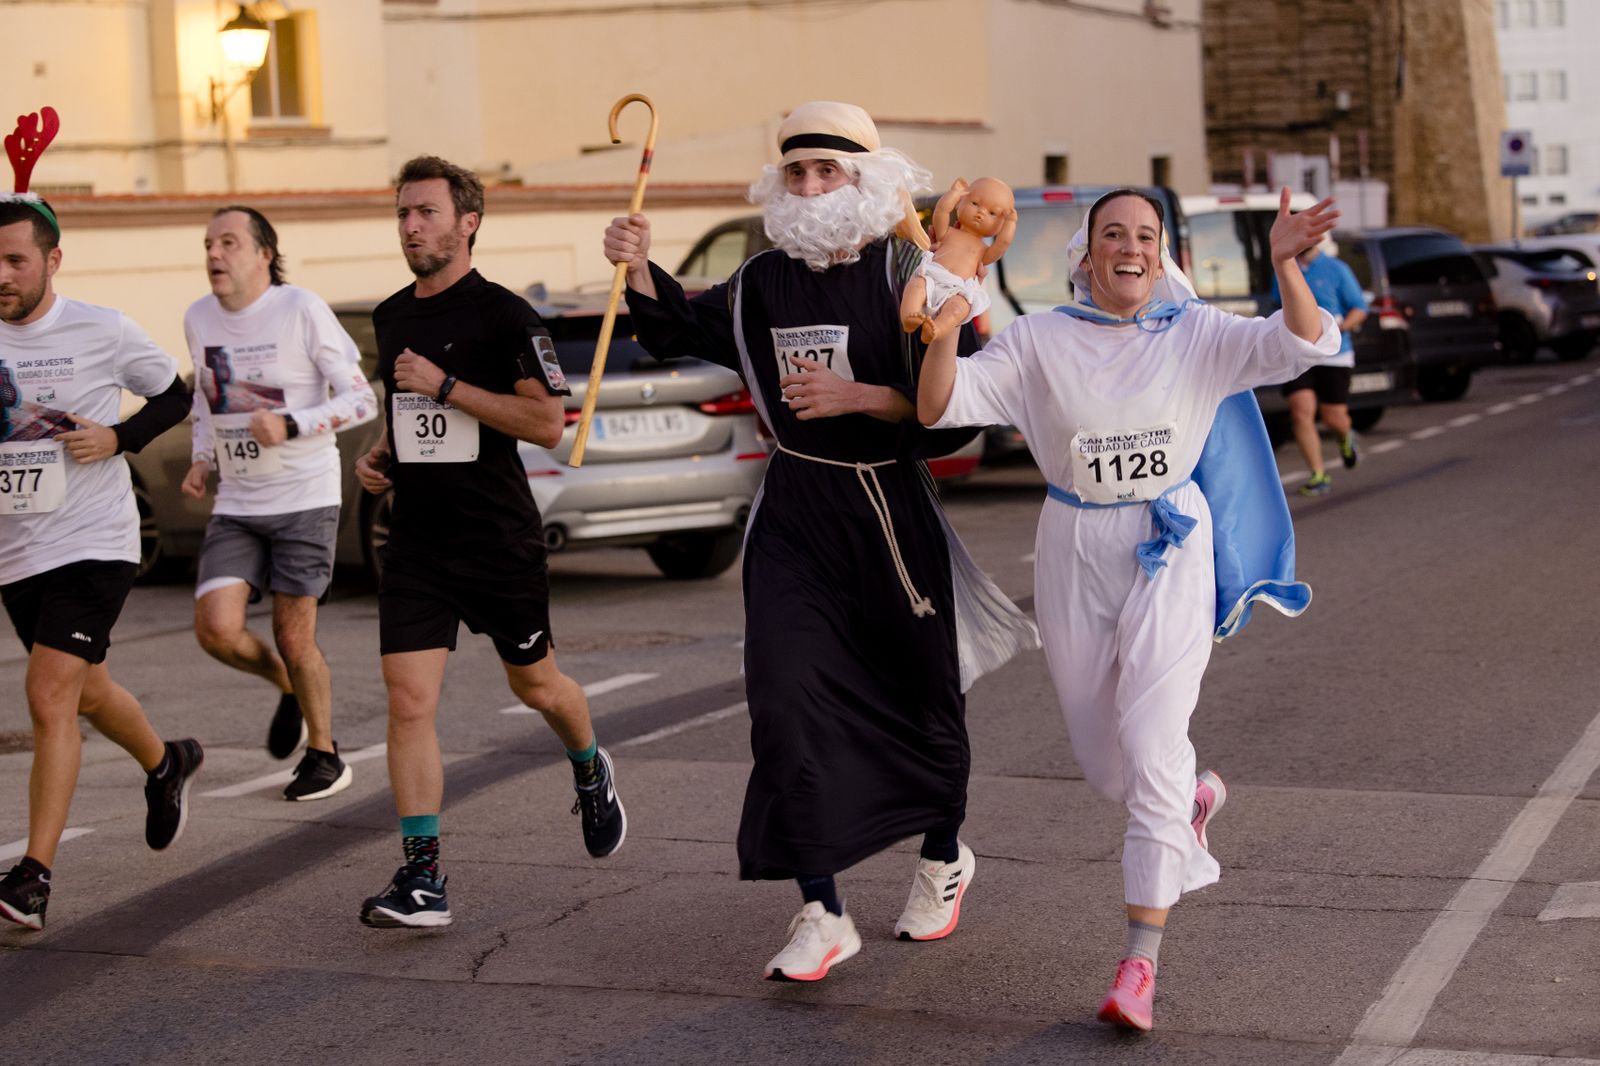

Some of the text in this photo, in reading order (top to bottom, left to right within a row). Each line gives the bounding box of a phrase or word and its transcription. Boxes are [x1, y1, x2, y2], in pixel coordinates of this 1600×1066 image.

[786, 329, 841, 339] SILVESTRE
[800, 338, 812, 347] DE
[17, 357, 75, 369] SAN SILVESTRE
[17, 369, 43, 380] CIUDAD
[44, 369, 53, 378] DE
[397, 402, 427, 411] CIUDAD
[415, 413, 447, 438] 30
[1079, 428, 1172, 446] SAN SILVESTRE
[224, 440, 260, 461] 149
[1079, 441, 1121, 454] CIUDAD
[1122, 440, 1138, 451] DE
[3, 450, 58, 460] SILVESTRE
[16, 458, 28, 466] DE
[1087, 450, 1169, 484] 1128
[0, 468, 44, 493] 377
